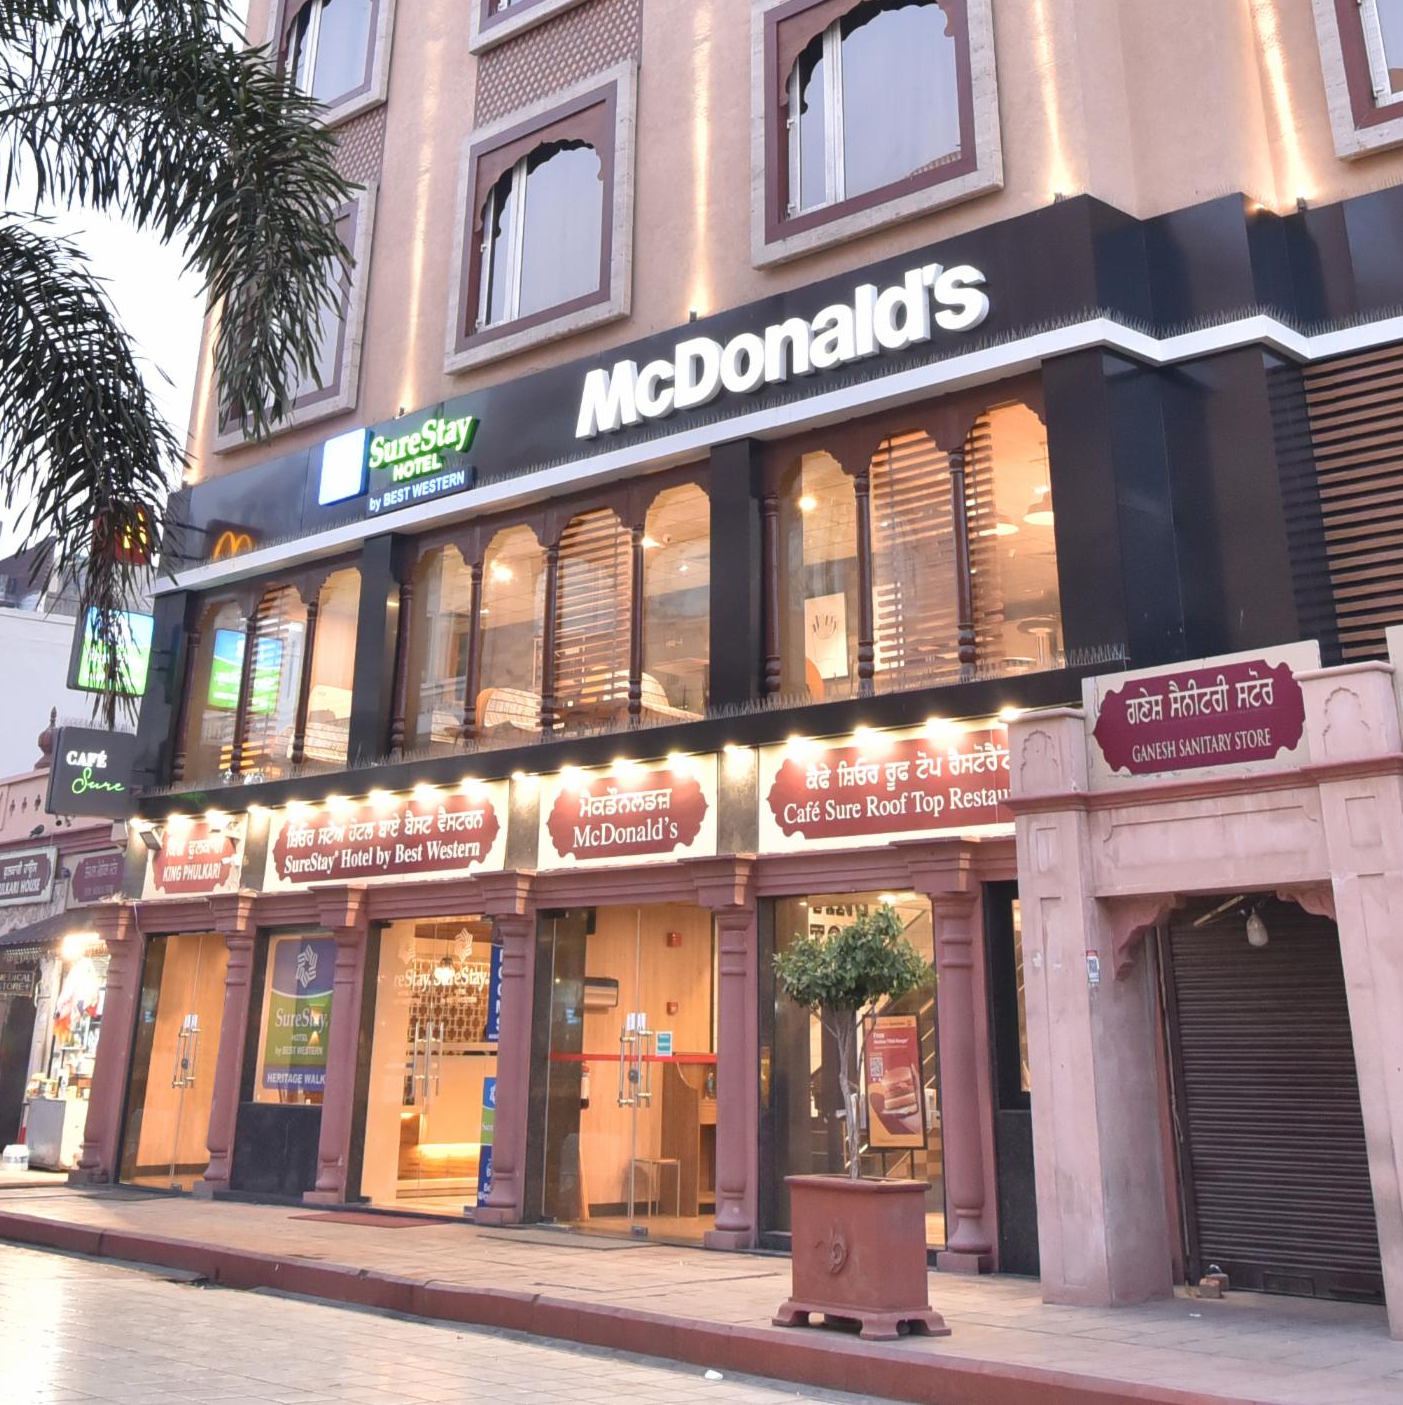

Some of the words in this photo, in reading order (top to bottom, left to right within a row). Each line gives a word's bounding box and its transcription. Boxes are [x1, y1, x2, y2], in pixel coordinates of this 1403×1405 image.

[575, 262, 990, 439] McDonald's
[369, 416, 473, 468] SureStay
[393, 453, 442, 482] HOTEL
[369, 497, 381, 512] by
[383, 486, 411, 507] BEST
[412, 470, 465, 498] WESTERN
[1169, 674, 1229, 719] ਸੈਨੀਟਰੀ
[1235, 668, 1274, 709] ਸਟੋਰ
[66, 750, 107, 768] CAFÉ
[1132, 741, 1177, 763] GANESH
[1179, 733, 1232, 758] SANITARY
[1234, 728, 1271, 750] STORE
[72, 767, 125, 794] Sure
[783, 801, 821, 824] Café
[825, 799, 862, 821] Sure
[866, 792, 908, 817] Roof
[911, 790, 944, 817] Top
[948, 787, 1012, 810] Restau
[572, 816, 678, 848] McDonald's
[341, 847, 373, 868] Hotel
[376, 846, 391, 870] by
[395, 843, 423, 864] Best
[426, 840, 480, 860] Western
[20, 878, 41, 894] HOUSE
[162, 865, 182, 882] KING
[182, 862, 221, 881] PHULKARI
[267, 1073, 303, 1084] HERITAGE
[304, 1073, 326, 1084] WALK
